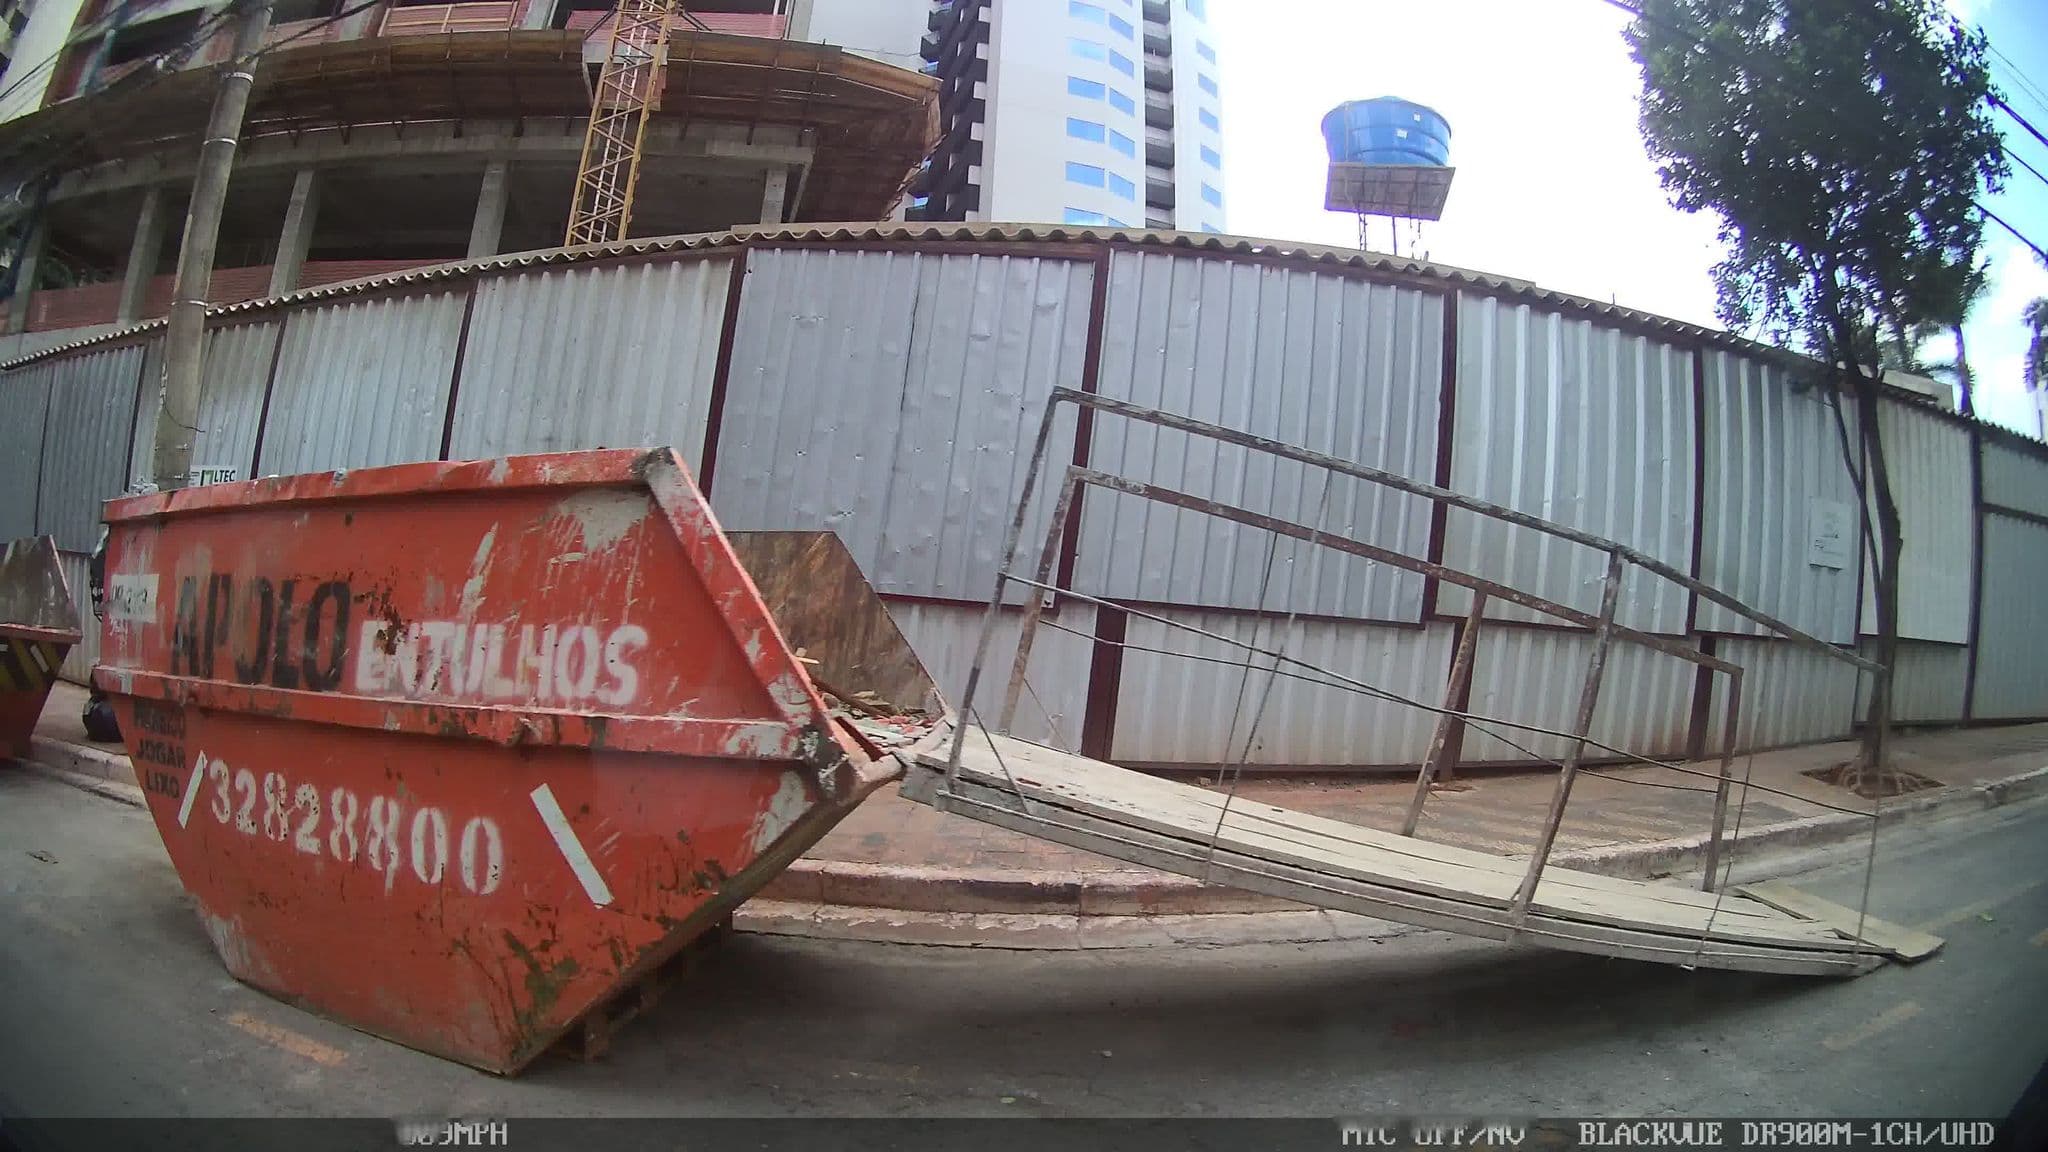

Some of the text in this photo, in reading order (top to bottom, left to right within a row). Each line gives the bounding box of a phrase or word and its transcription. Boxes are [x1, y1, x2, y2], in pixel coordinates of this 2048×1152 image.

[355, 620, 649, 705] ENTULHOS
[138, 738, 186, 769] JOGAR
[145, 768, 180, 799] LIXO
[209, 757, 503, 896] 32828800
